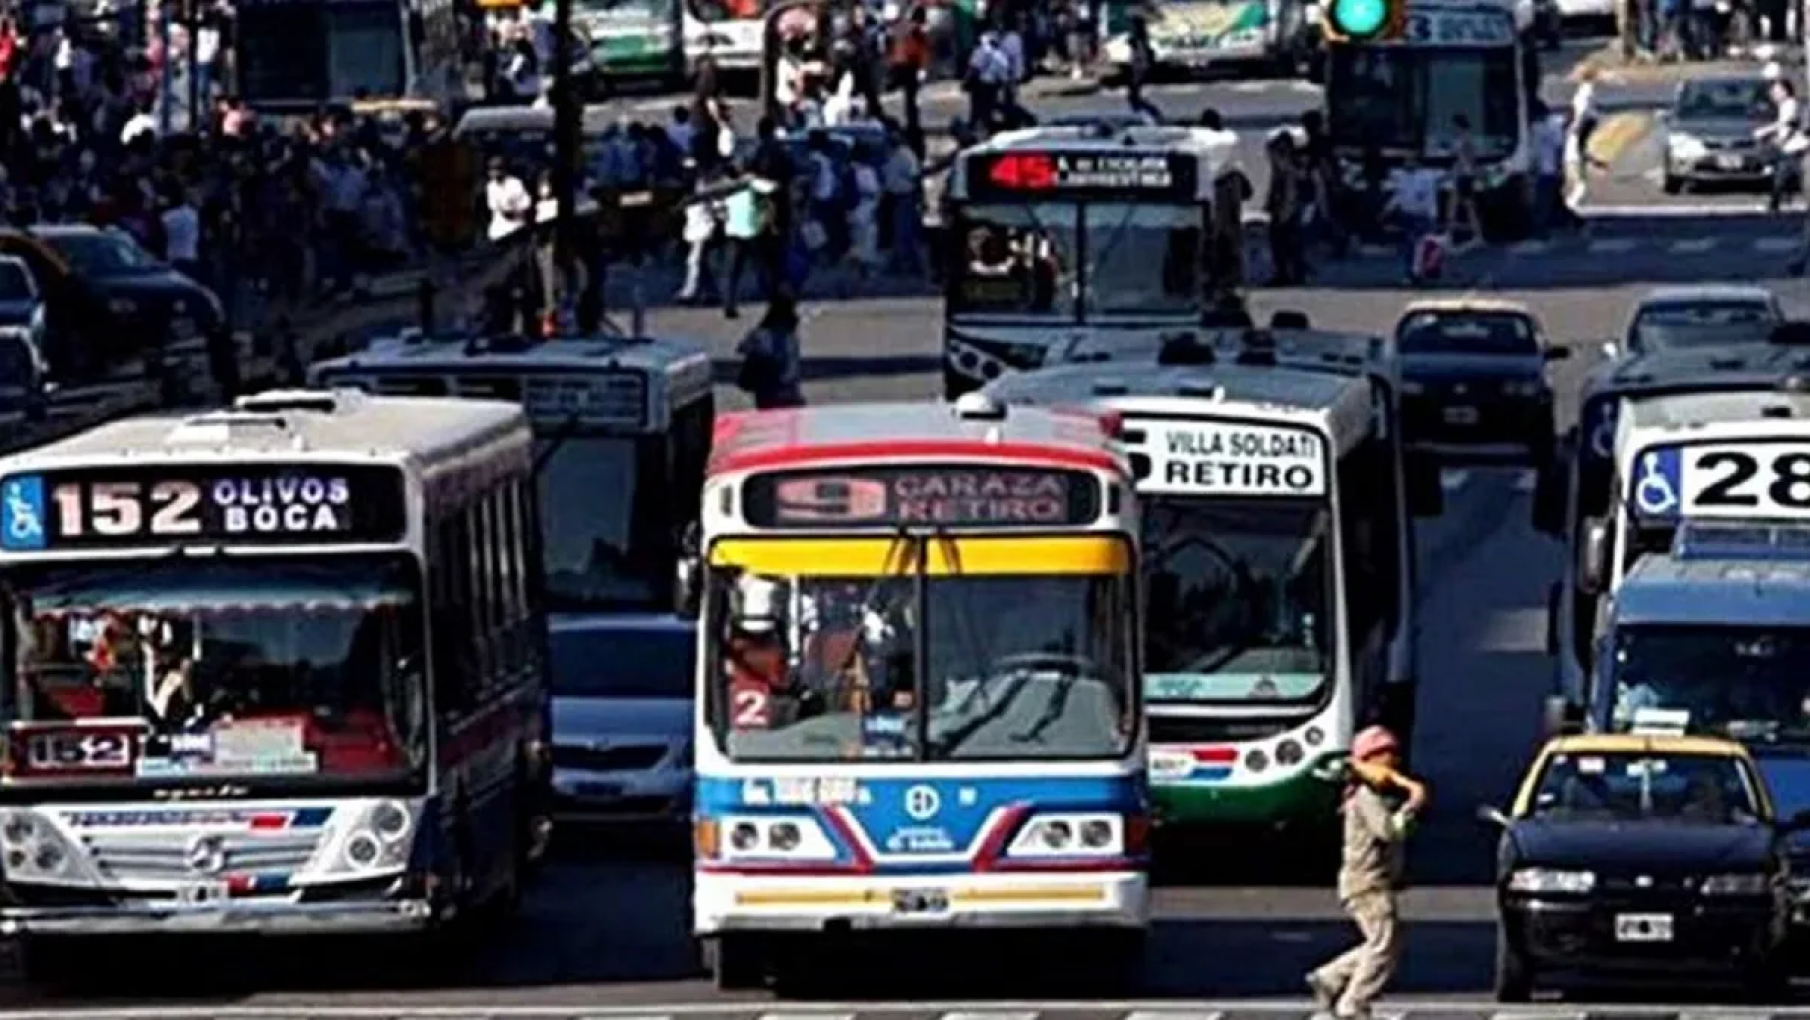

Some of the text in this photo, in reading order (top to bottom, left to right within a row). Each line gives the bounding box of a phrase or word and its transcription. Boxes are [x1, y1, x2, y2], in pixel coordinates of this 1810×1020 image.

[990, 155, 1056, 187] 45
[1166, 431, 1316, 458] VILLA SOLDATI
[1166, 460, 1314, 488] RETIRO
[1694, 451, 1810, 508] 28
[213, 478, 349, 504] OLIVOS
[777, 478, 887, 519] 9
[53, 480, 201, 536] 152
[225, 505, 338, 532] BOCA
[899, 499, 1061, 521] RETIRO
[735, 690, 768, 726] 2
[28, 735, 129, 767] 152
